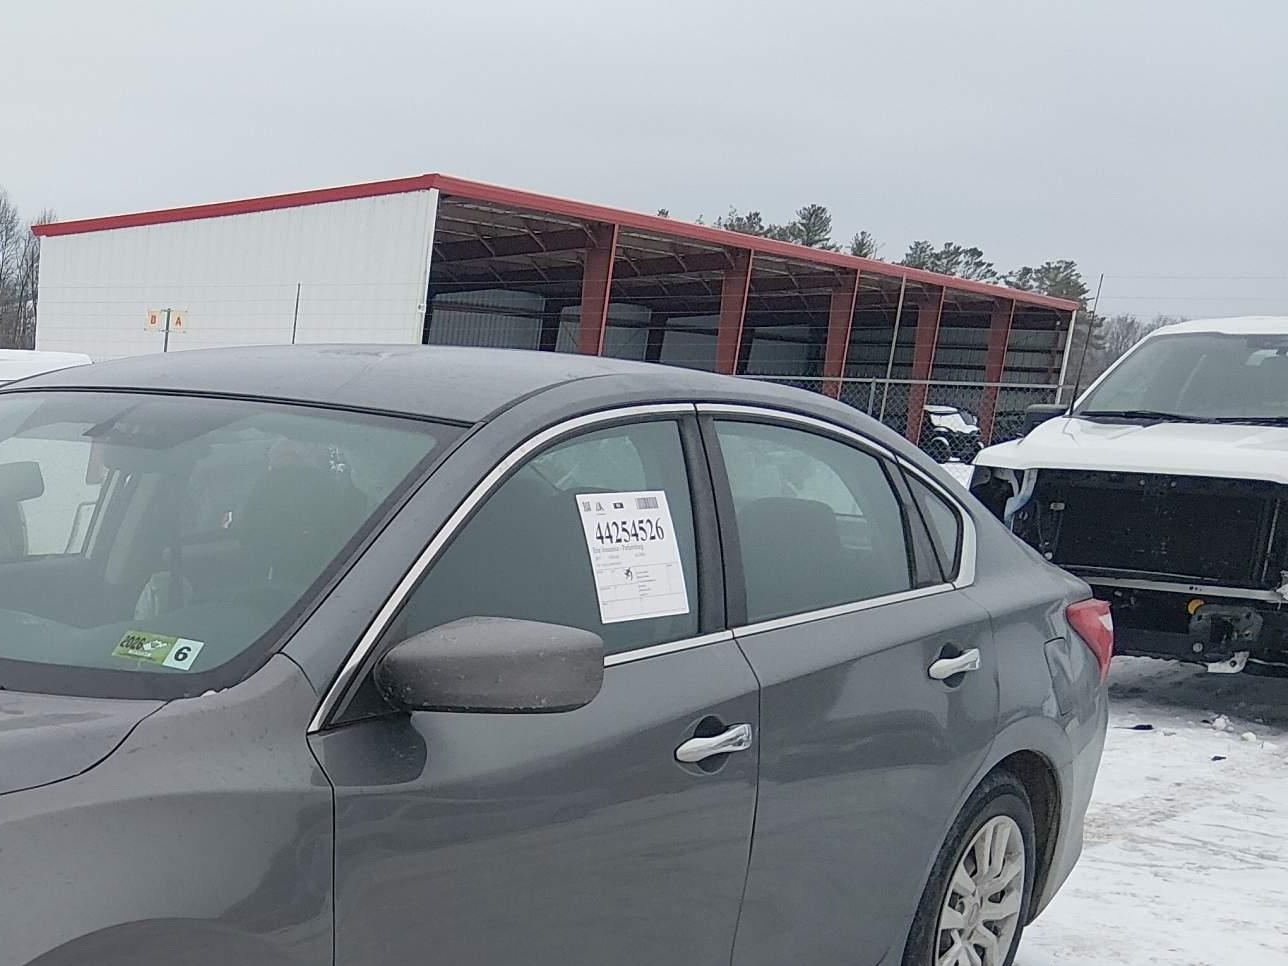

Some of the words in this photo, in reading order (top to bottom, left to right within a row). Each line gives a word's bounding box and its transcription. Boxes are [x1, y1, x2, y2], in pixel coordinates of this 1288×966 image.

[174, 316, 182, 327] A
[595, 518, 665, 544] 44254526
[119, 634, 147, 651] 2026
[174, 646, 192, 662] 6
